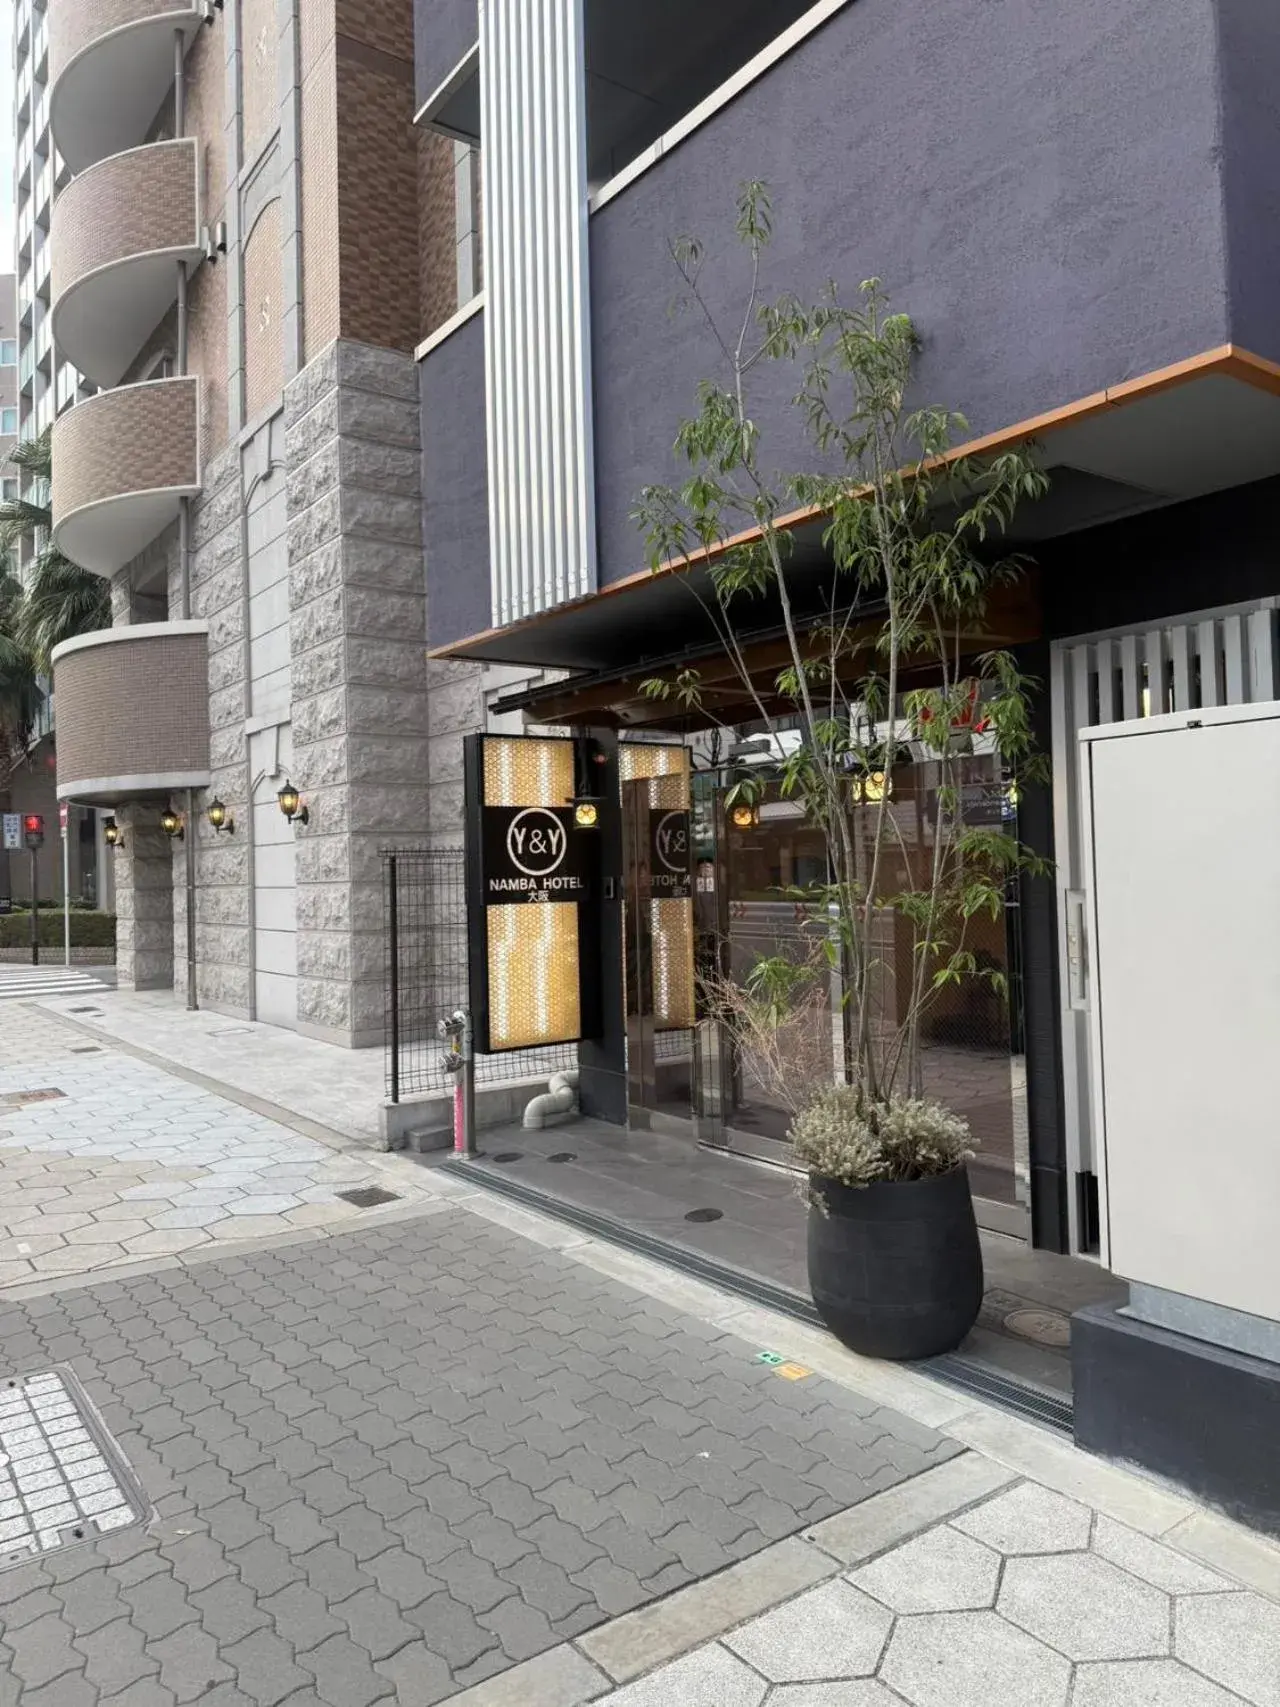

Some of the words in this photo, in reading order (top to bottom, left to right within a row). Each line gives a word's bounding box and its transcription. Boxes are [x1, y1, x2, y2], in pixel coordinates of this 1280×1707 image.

[513, 827, 561, 855] Y&Y
[489, 878, 538, 892] NAMBA
[543, 876, 585, 890] HOTEL
[527, 890, 550, 903] 大阪
